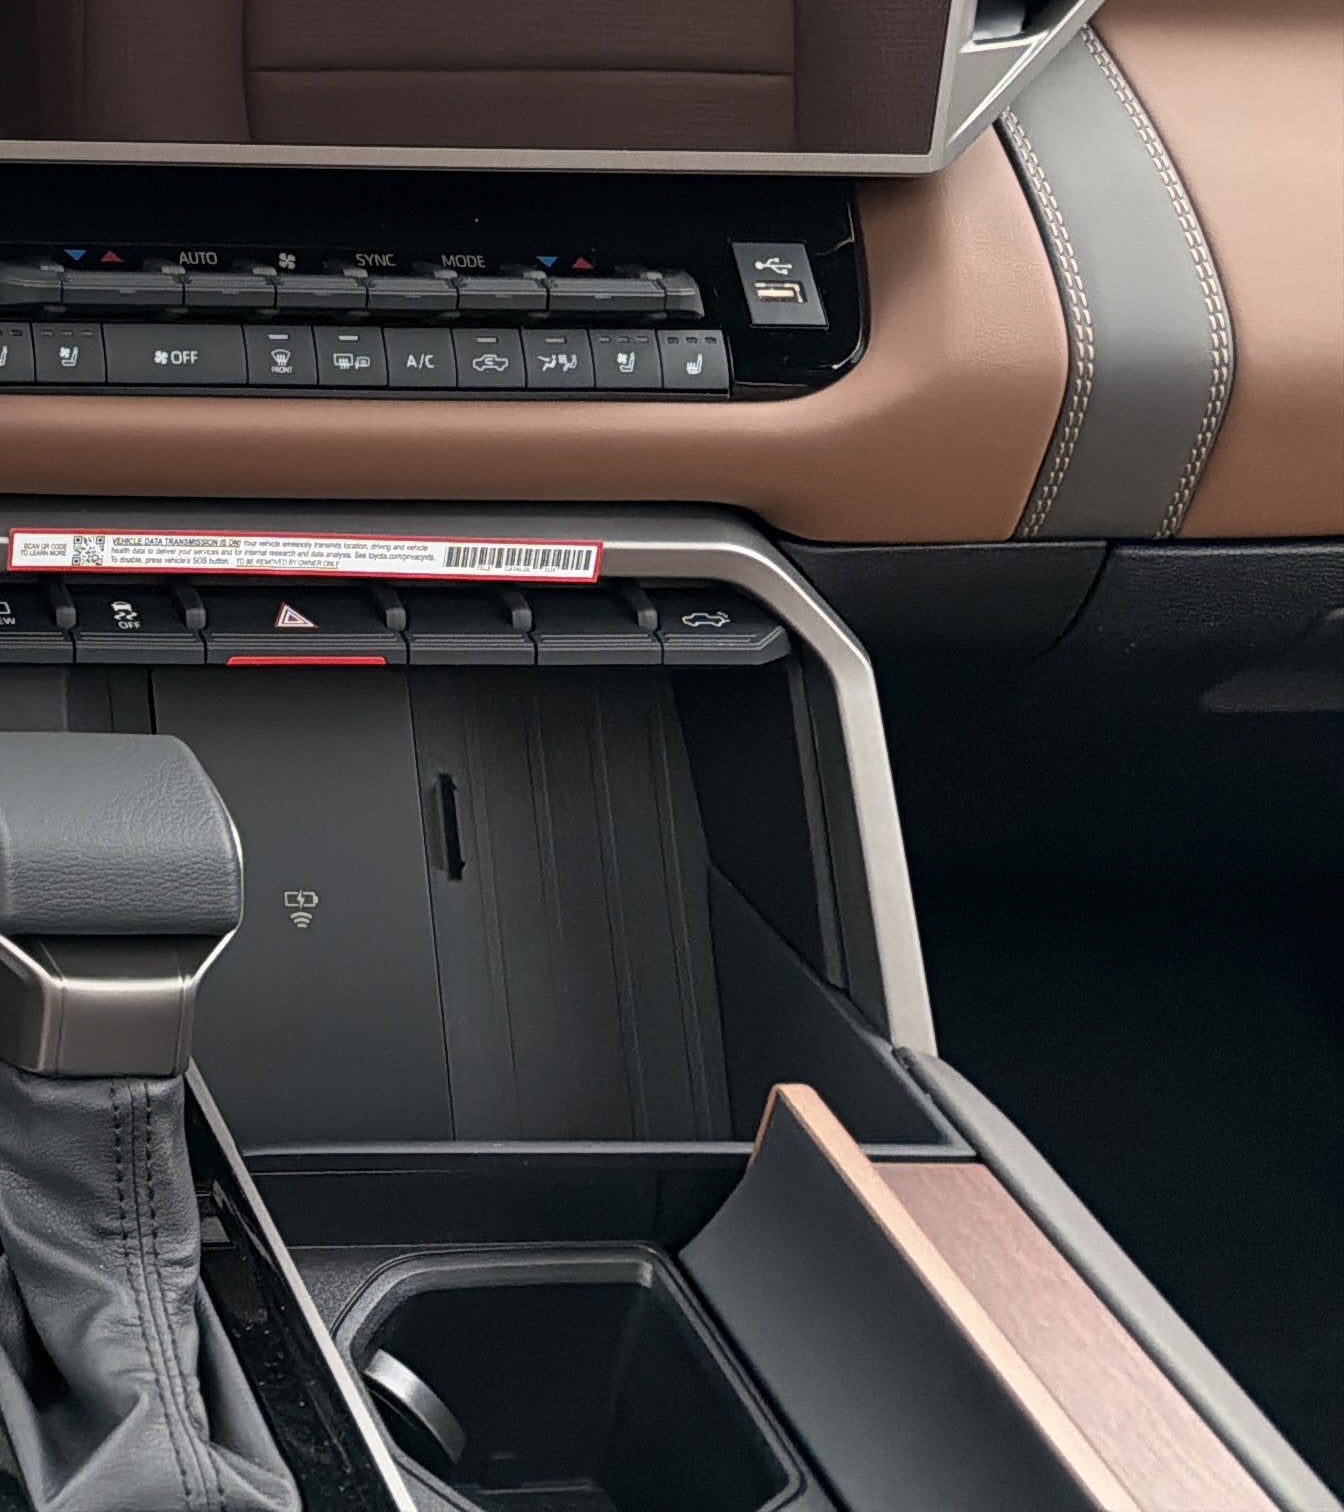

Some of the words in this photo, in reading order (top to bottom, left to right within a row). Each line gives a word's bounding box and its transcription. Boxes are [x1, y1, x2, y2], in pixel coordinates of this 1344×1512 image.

[178, 251, 218, 265] AUTO
[355, 253, 395, 267] SYNC
[441, 254, 486, 269] MODE
[170, 350, 198, 365] OFF
[406, 354, 435, 369] A/C
[270, 365, 293, 373] FRONT
[113, 538, 142, 546] VEHICLE
[145, 538, 163, 546] DATA
[165, 538, 218, 547] TRANSMISSION
[118, 621, 140, 630] OFF
